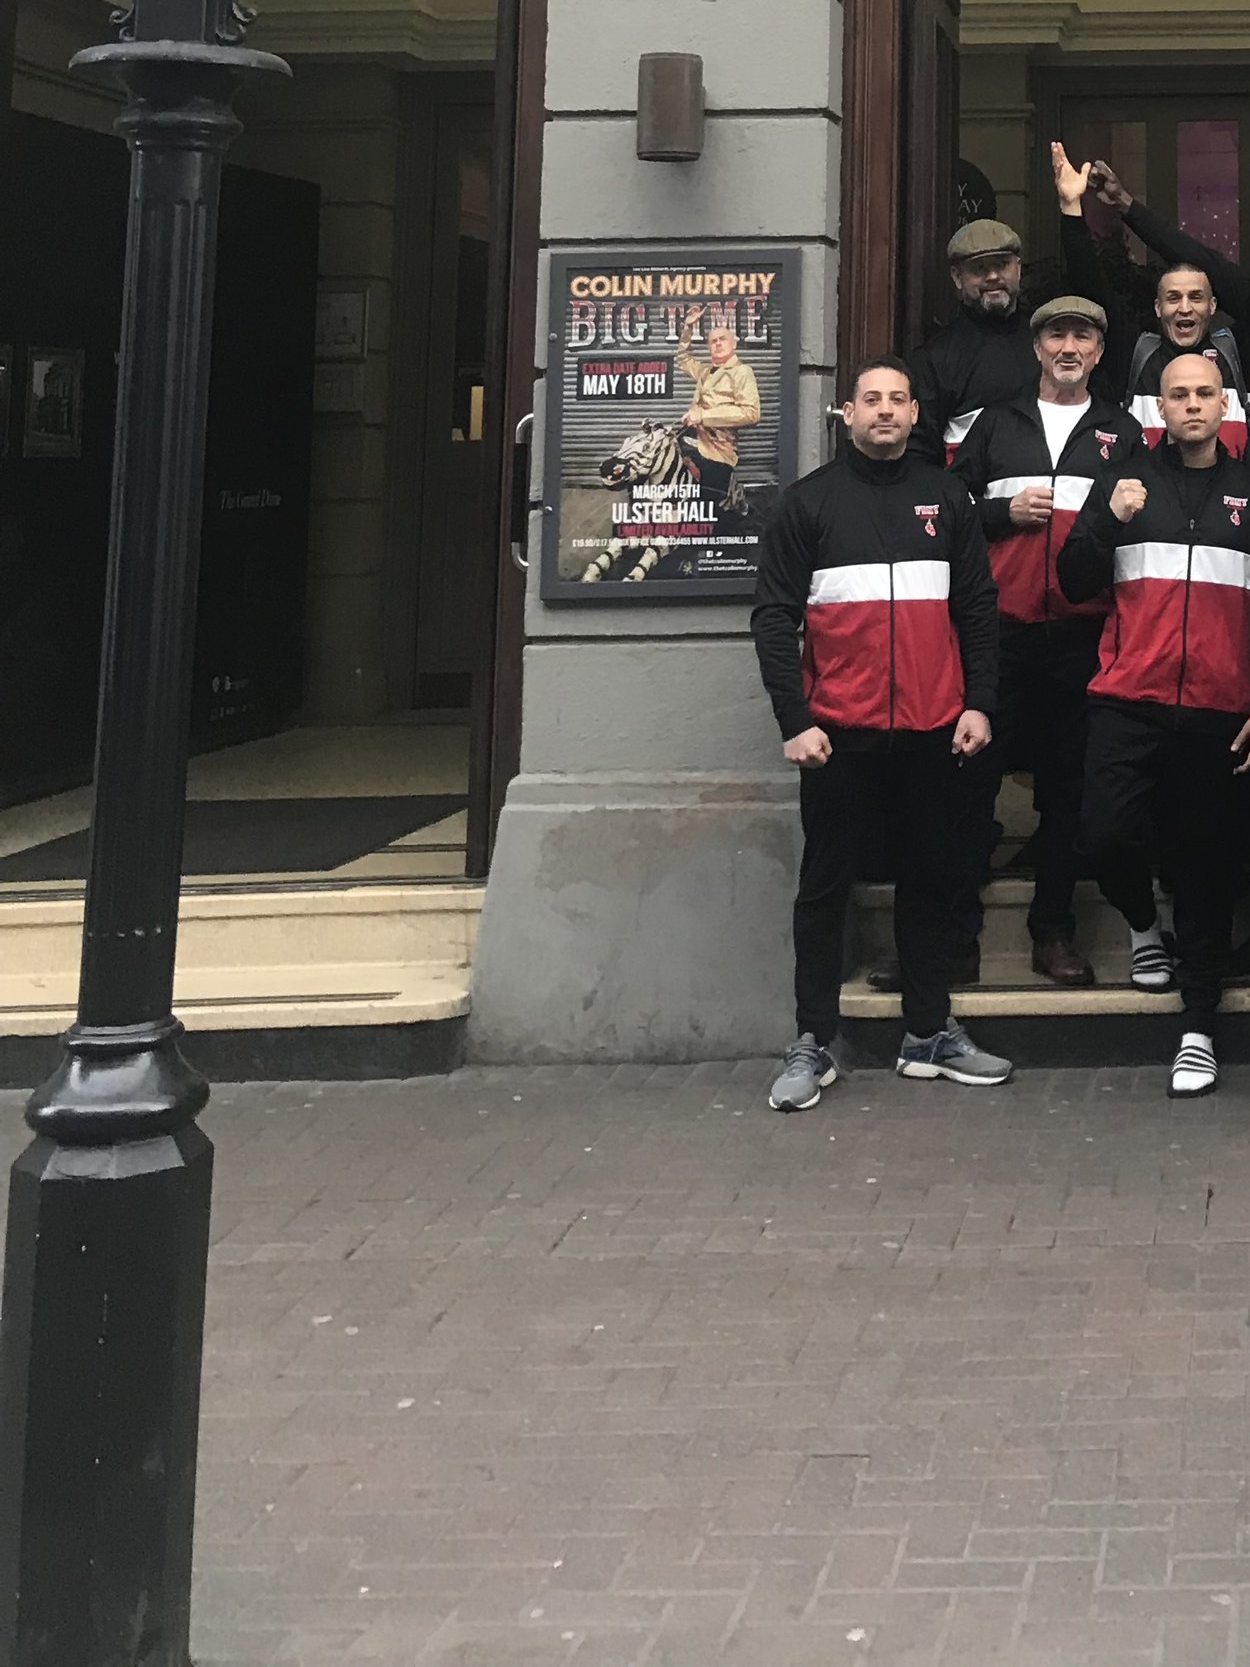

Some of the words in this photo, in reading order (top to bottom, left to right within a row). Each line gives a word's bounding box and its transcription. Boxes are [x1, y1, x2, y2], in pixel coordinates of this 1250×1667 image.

[570, 274, 653, 298] COLIN
[659, 272, 776, 297] MURPHY
[567, 299, 649, 349] BIG
[659, 295, 768, 344] TIME
[582, 362, 611, 374] EXTRA
[637, 361, 668, 373] ADDED
[583, 374, 620, 396] MAY
[626, 373, 666, 395] 18TH
[632, 484, 673, 499] MARCH
[674, 483, 700, 498] 15TH
[612, 502, 674, 524] ULSTER
[677, 501, 719, 522] HALL
[617, 523, 654, 537] LIMITED
[655, 522, 714, 536] AVAILABILITY
[692, 536, 759, 545] WWW.ULSTERHALL.COM
